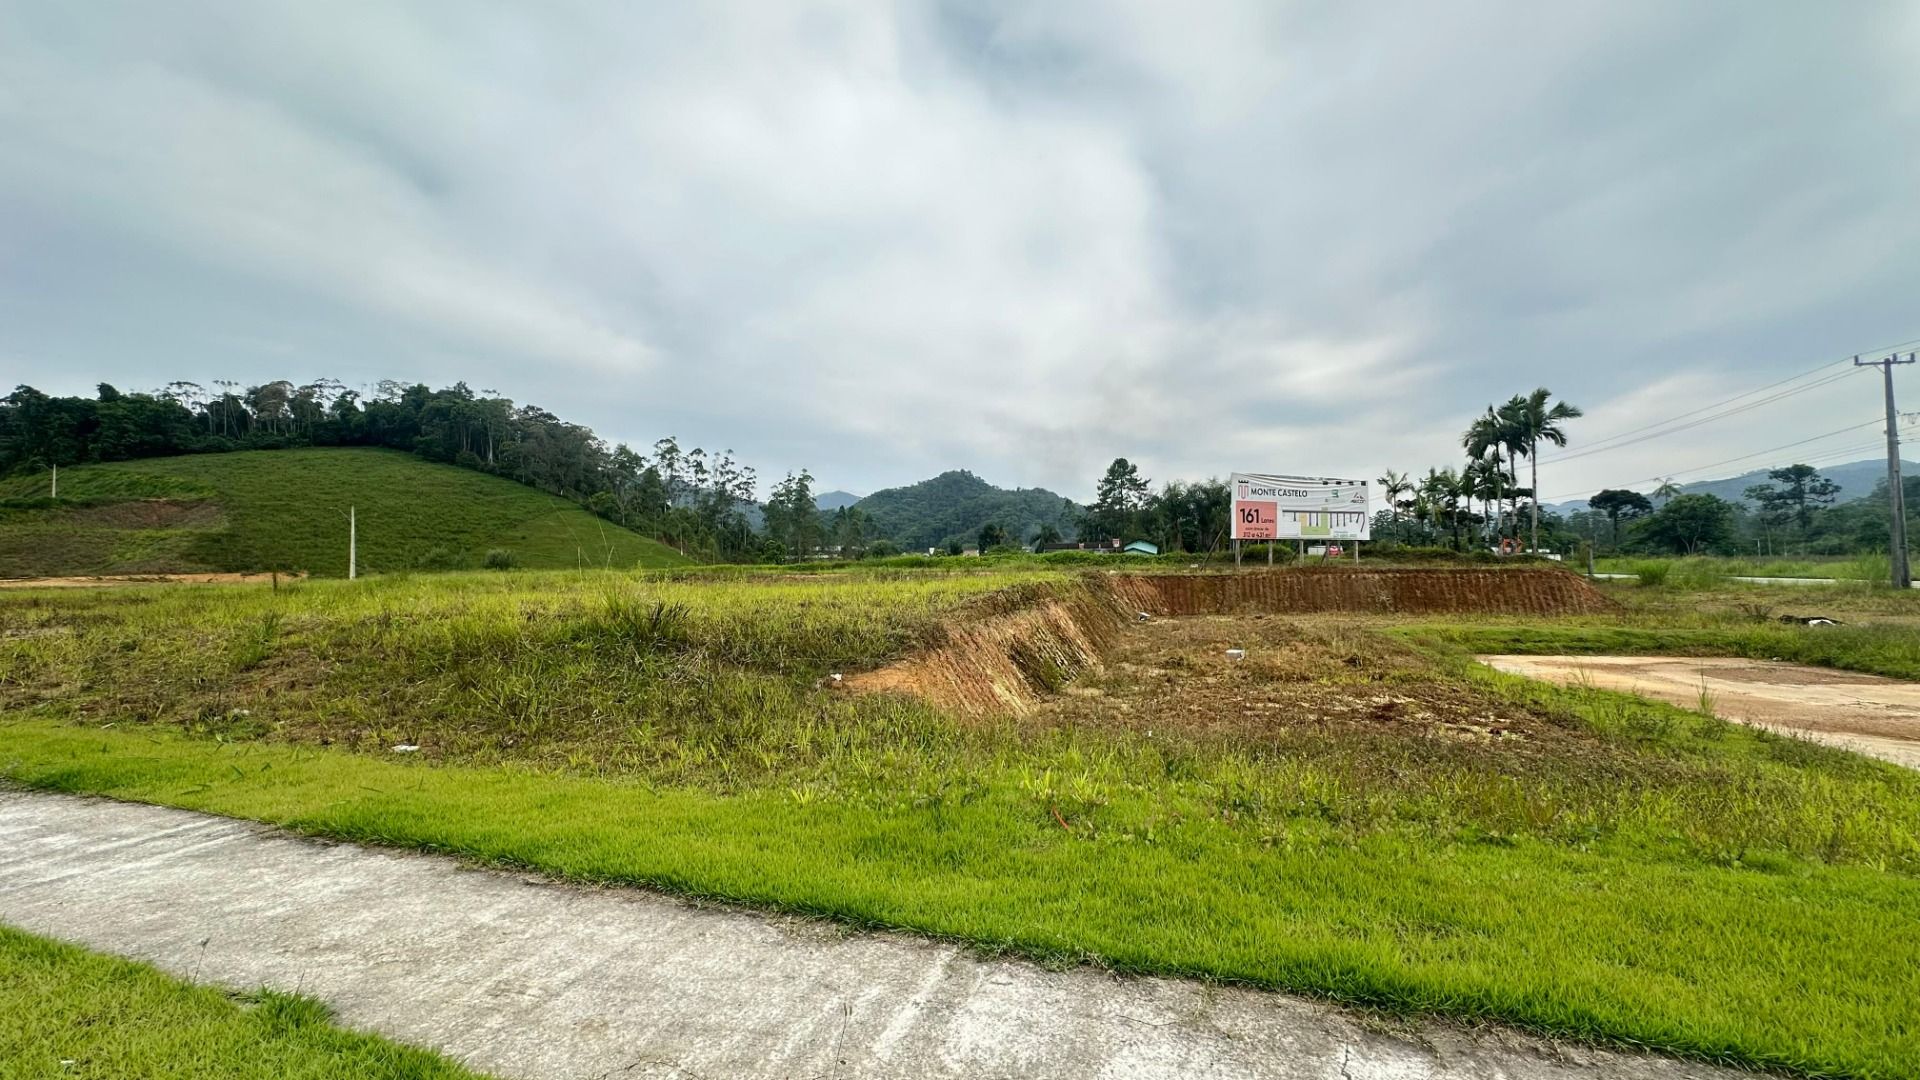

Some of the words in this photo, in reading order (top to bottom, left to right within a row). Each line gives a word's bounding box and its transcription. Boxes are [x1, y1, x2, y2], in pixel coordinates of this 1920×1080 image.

[1251, 488, 1276, 496] MONTE
[1278, 489, 1307, 497] CASTELO
[1240, 508, 1259, 523] 161
